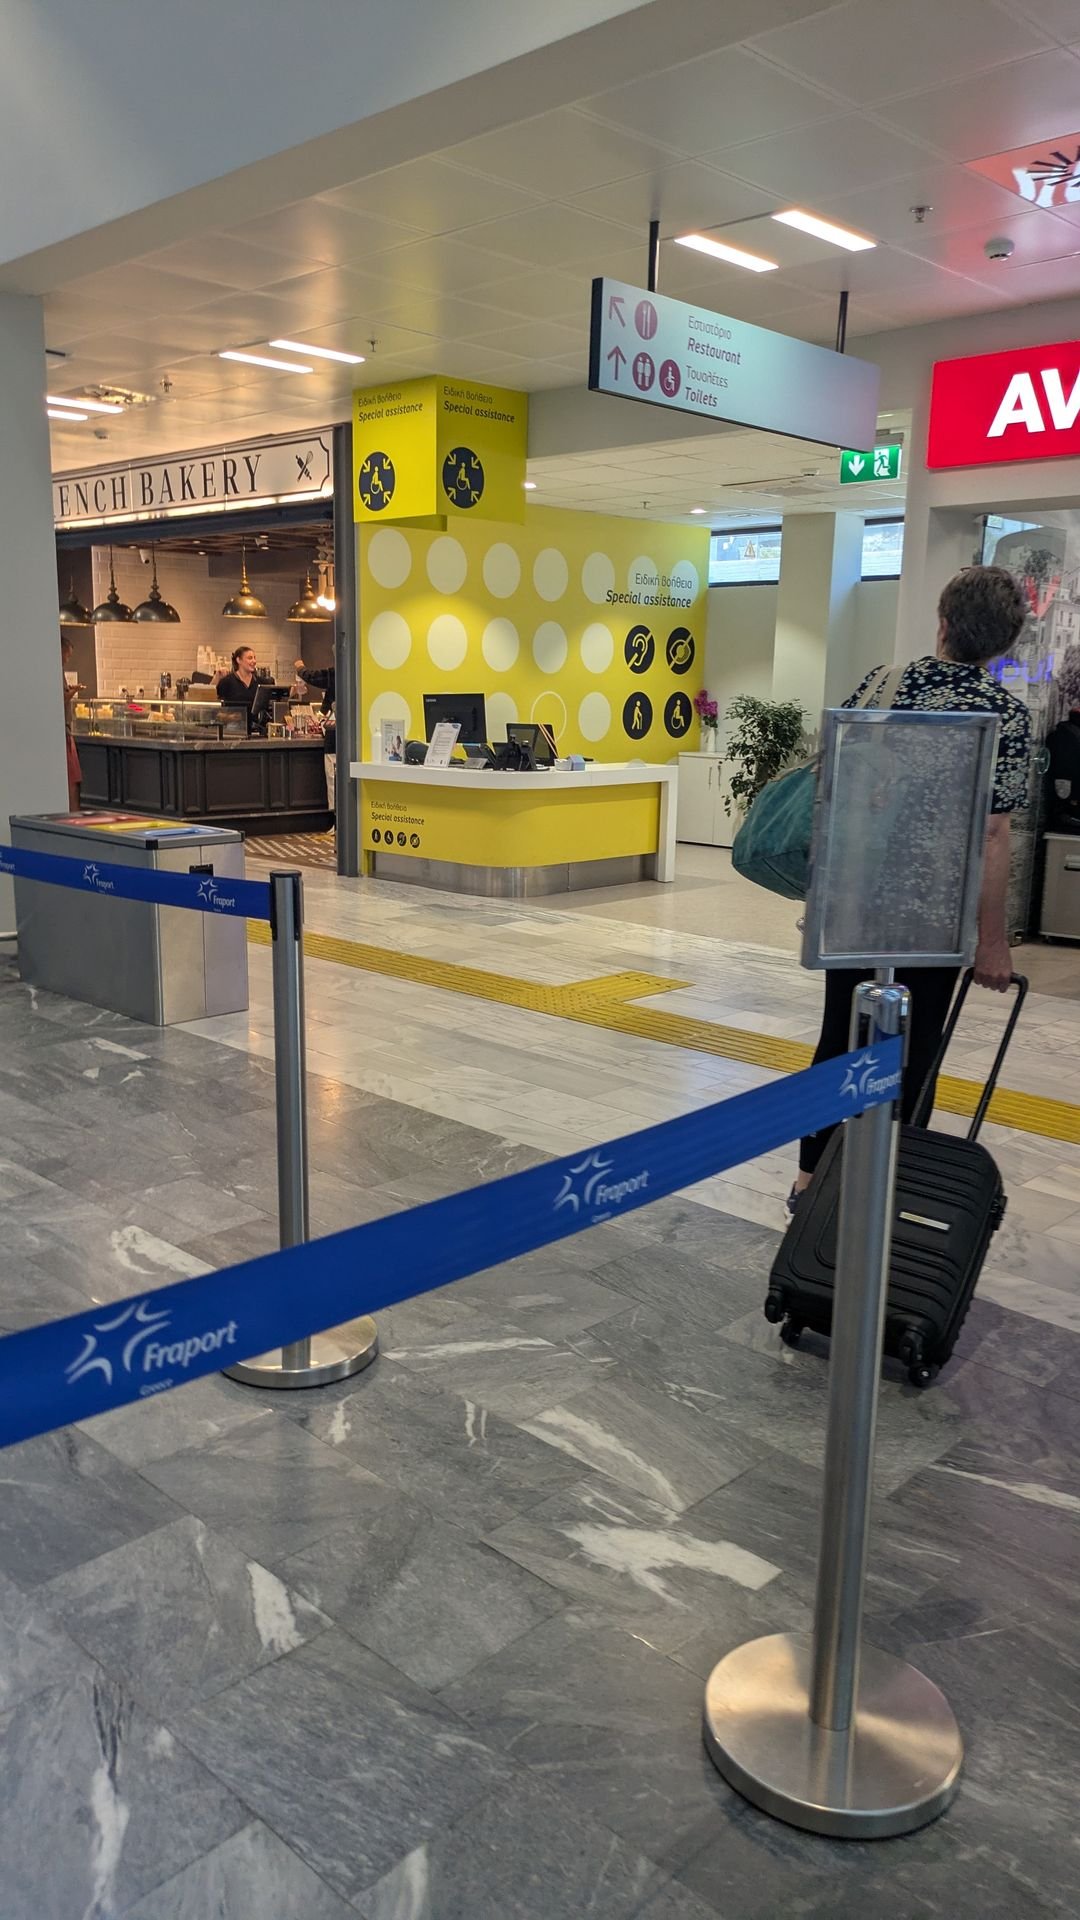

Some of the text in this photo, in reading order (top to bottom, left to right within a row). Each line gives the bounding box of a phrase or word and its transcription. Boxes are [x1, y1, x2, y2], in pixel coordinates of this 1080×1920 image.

[688, 315, 732, 340] Εστιατόριο
[687, 337, 742, 365] Restaurant
[686, 365, 729, 388] Τουαλέτες
[685, 387, 718, 407] Toilets
[985, 366, 1080, 438] AV
[358, 403, 424, 423] Special assistance
[443, 400, 515, 424] Special assistance
[140, 454, 262, 506] BAKERY
[635, 572, 660, 587] Ειδική
[605, 589, 692, 608] Special assistance
[371, 812, 425, 826] Special assistance
[213, 894, 235, 909] Fraport
[595, 1169, 650, 1206] Fraport
[143, 1319, 239, 1373] Fraport
